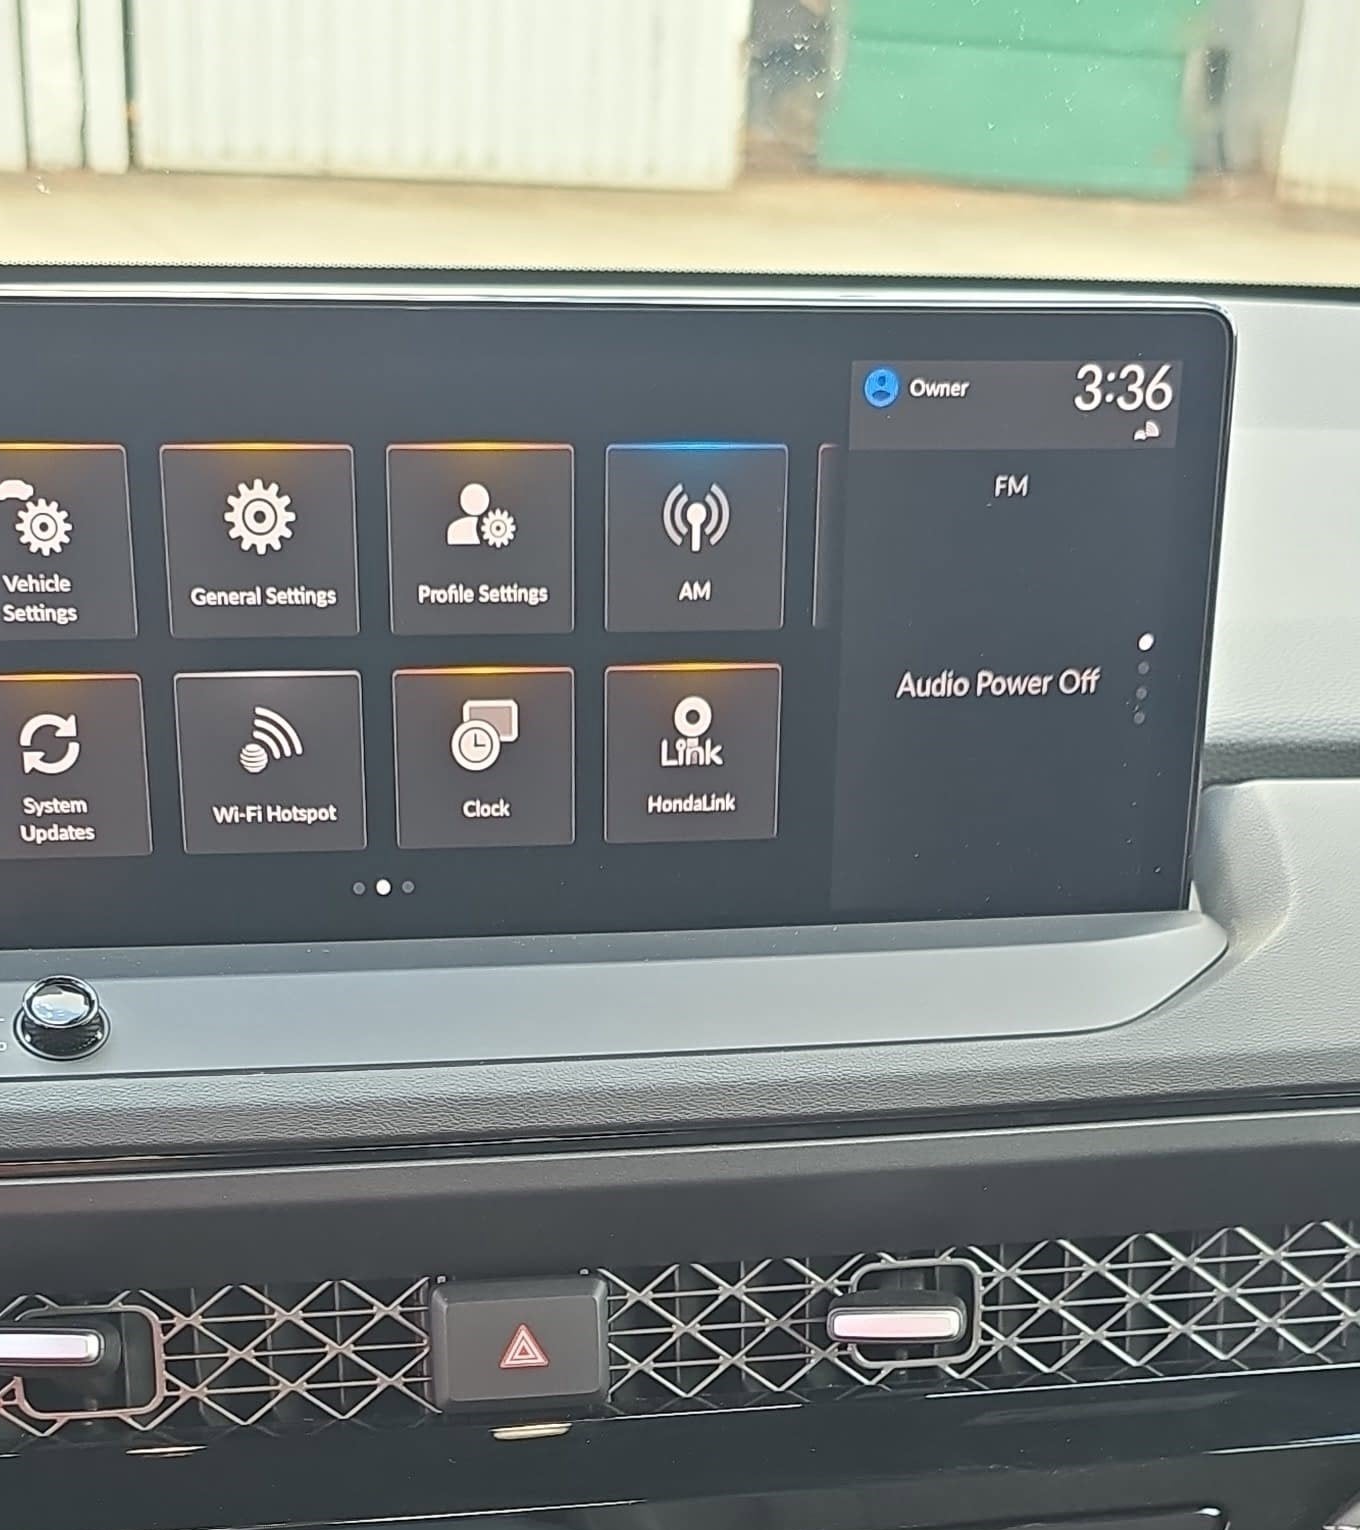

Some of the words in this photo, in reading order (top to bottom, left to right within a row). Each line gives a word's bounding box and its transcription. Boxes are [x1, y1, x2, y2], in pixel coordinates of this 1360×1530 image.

[910, 378, 970, 397] Owner
[1074, 363, 1173, 411] 3:36
[994, 474, 1029, 497] FM
[2, 573, 71, 593] Vehicle
[678, 580, 711, 601] AM
[190, 586, 262, 606] General
[265, 585, 337, 608] Settings
[418, 583, 475, 604] Profile
[478, 583, 548, 606] Settings
[2, 603, 78, 625] Settings
[896, 669, 970, 698] Audio
[976, 670, 1054, 697] Power
[1059, 667, 1101, 694] Off
[661, 738, 723, 766] Link
[23, 797, 88, 817] System
[463, 798, 510, 818] Clock
[647, 792, 736, 813] HondaLink
[212, 804, 263, 824] Wi-Fi
[266, 804, 337, 825] Hotspot
[20, 823, 95, 845] Updates
